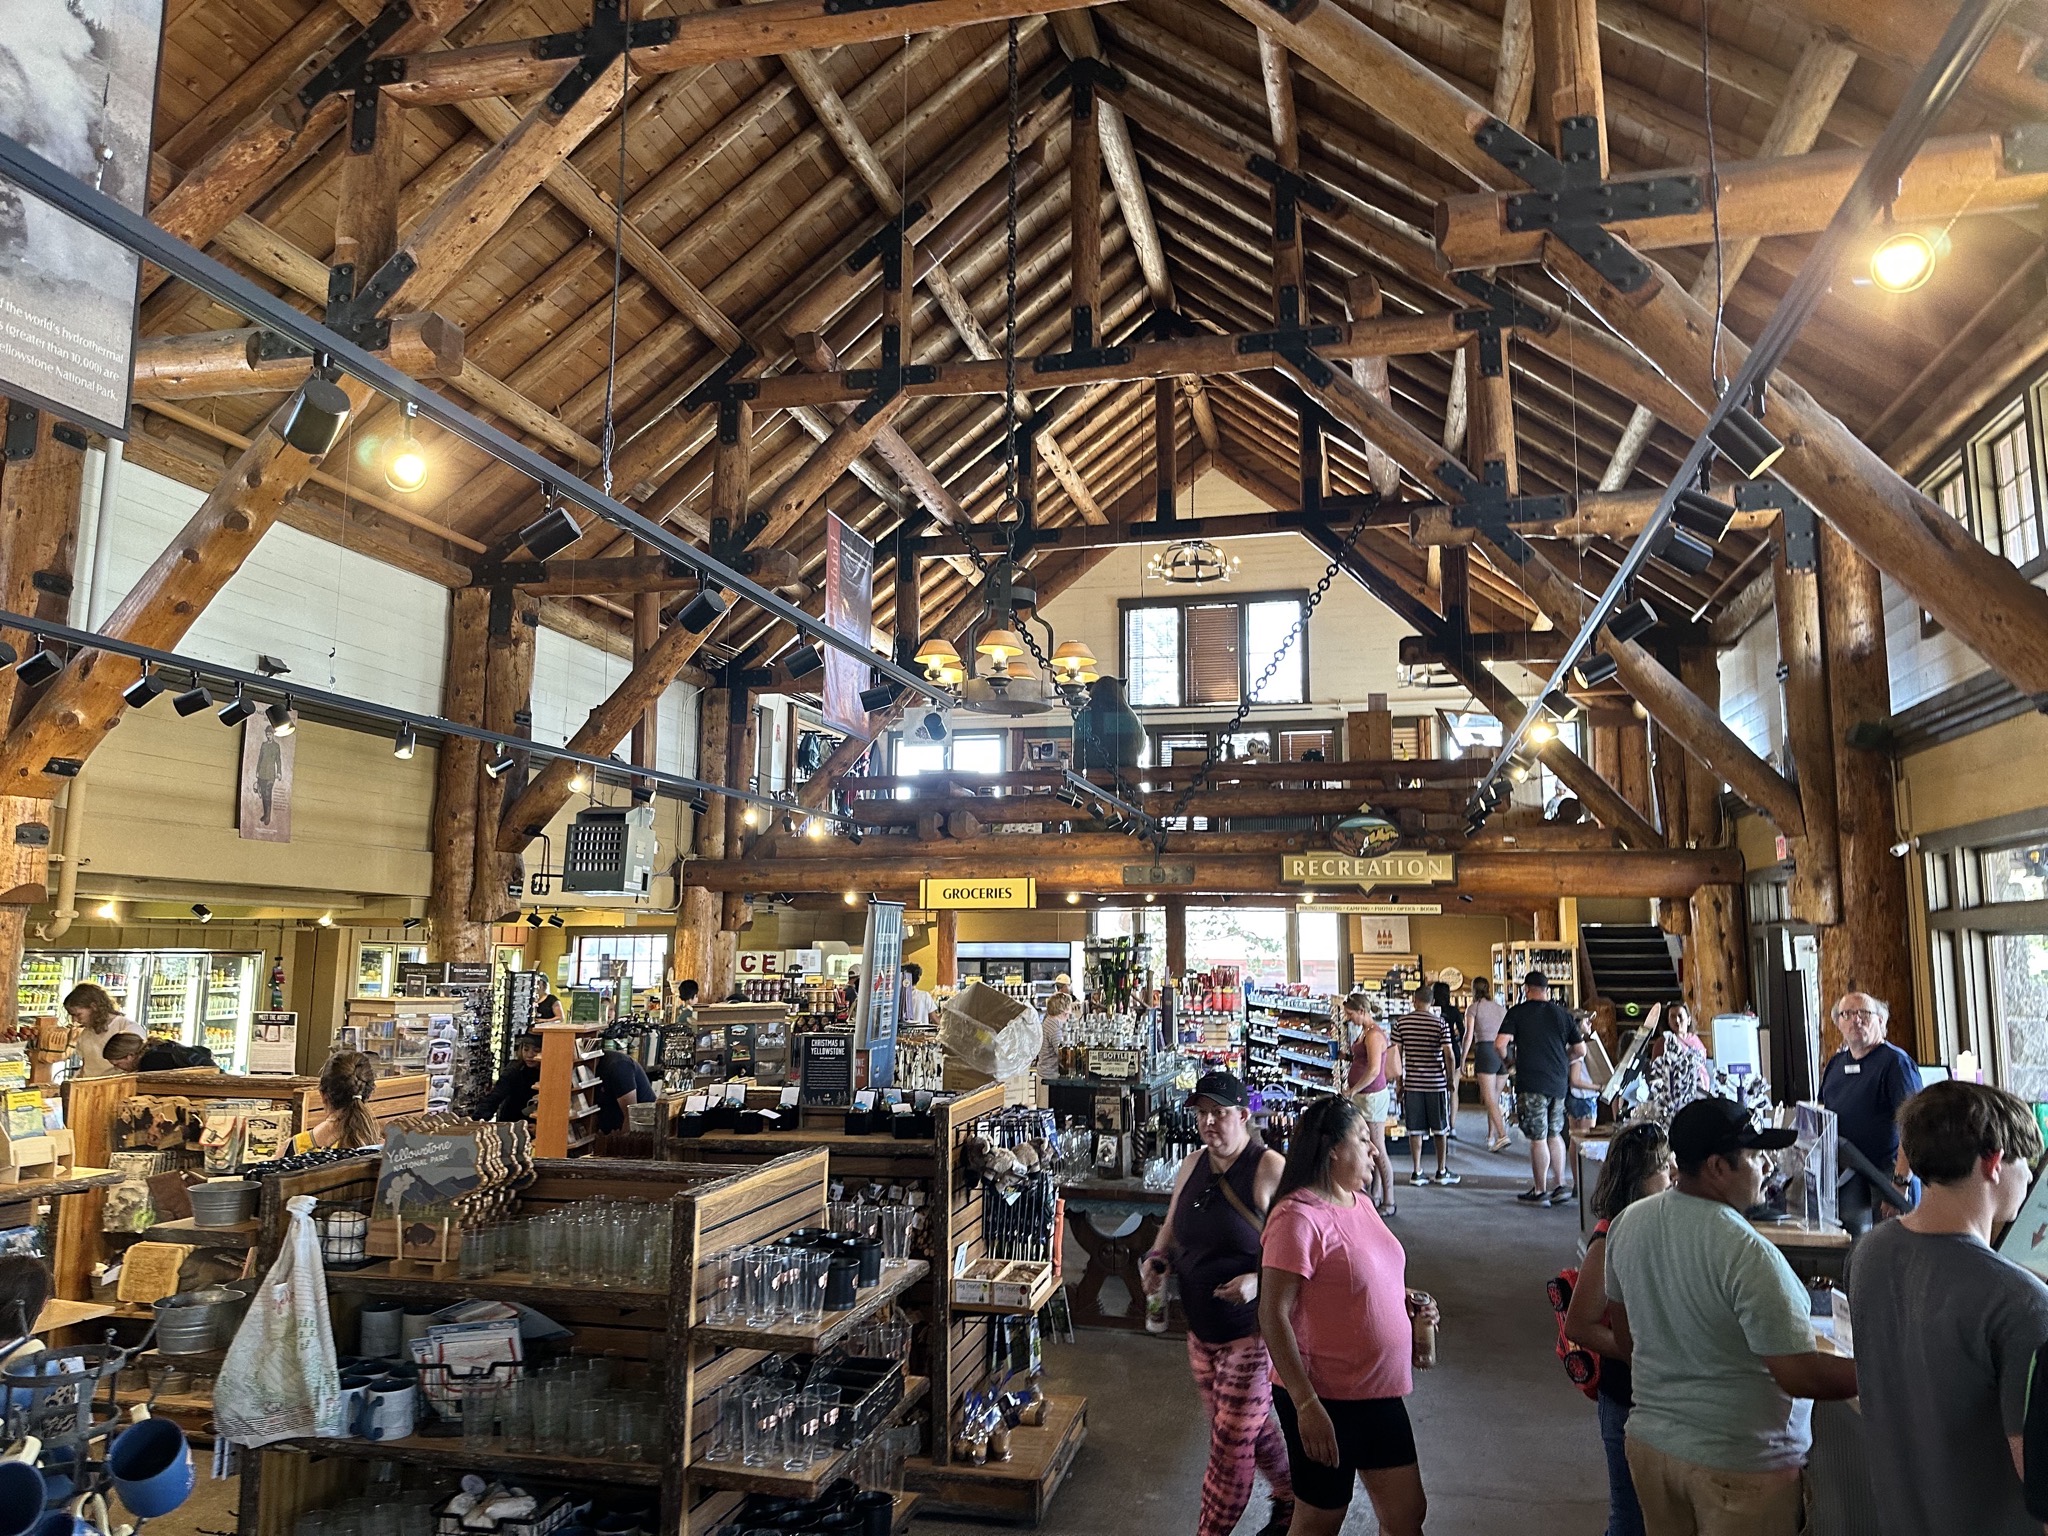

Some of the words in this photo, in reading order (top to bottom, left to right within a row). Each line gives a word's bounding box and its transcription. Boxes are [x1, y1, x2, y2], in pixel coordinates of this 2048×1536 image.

[6, 301, 23, 318] the
[24, 311, 61, 336] world's
[62, 327, 124, 364] hydrothermal
[5, 322, 46, 349] (greater
[47, 342, 69, 360] than
[70, 352, 103, 376] 10,000)
[103, 368, 120, 382] are
[0, 342, 54, 374] ellowstone
[55, 365, 96, 392] National
[96, 384, 119, 401] Park.
[1293, 859, 1443, 876] RECREATION
[943, 888, 1012, 899] GROCERIES
[740, 954, 777, 974] CE
[810, 1047, 845, 1056] YELLOWSTONE
[811, 1039, 838, 1047] CHRISTMAS
[839, 1039, 845, 1047] IN
[1103, 1051, 1128, 1060] BOTTLE
[386, 1140, 453, 1164] Yellowstone
[393, 1159, 428, 1172] NATIONAL
[430, 1153, 450, 1163] PARK
